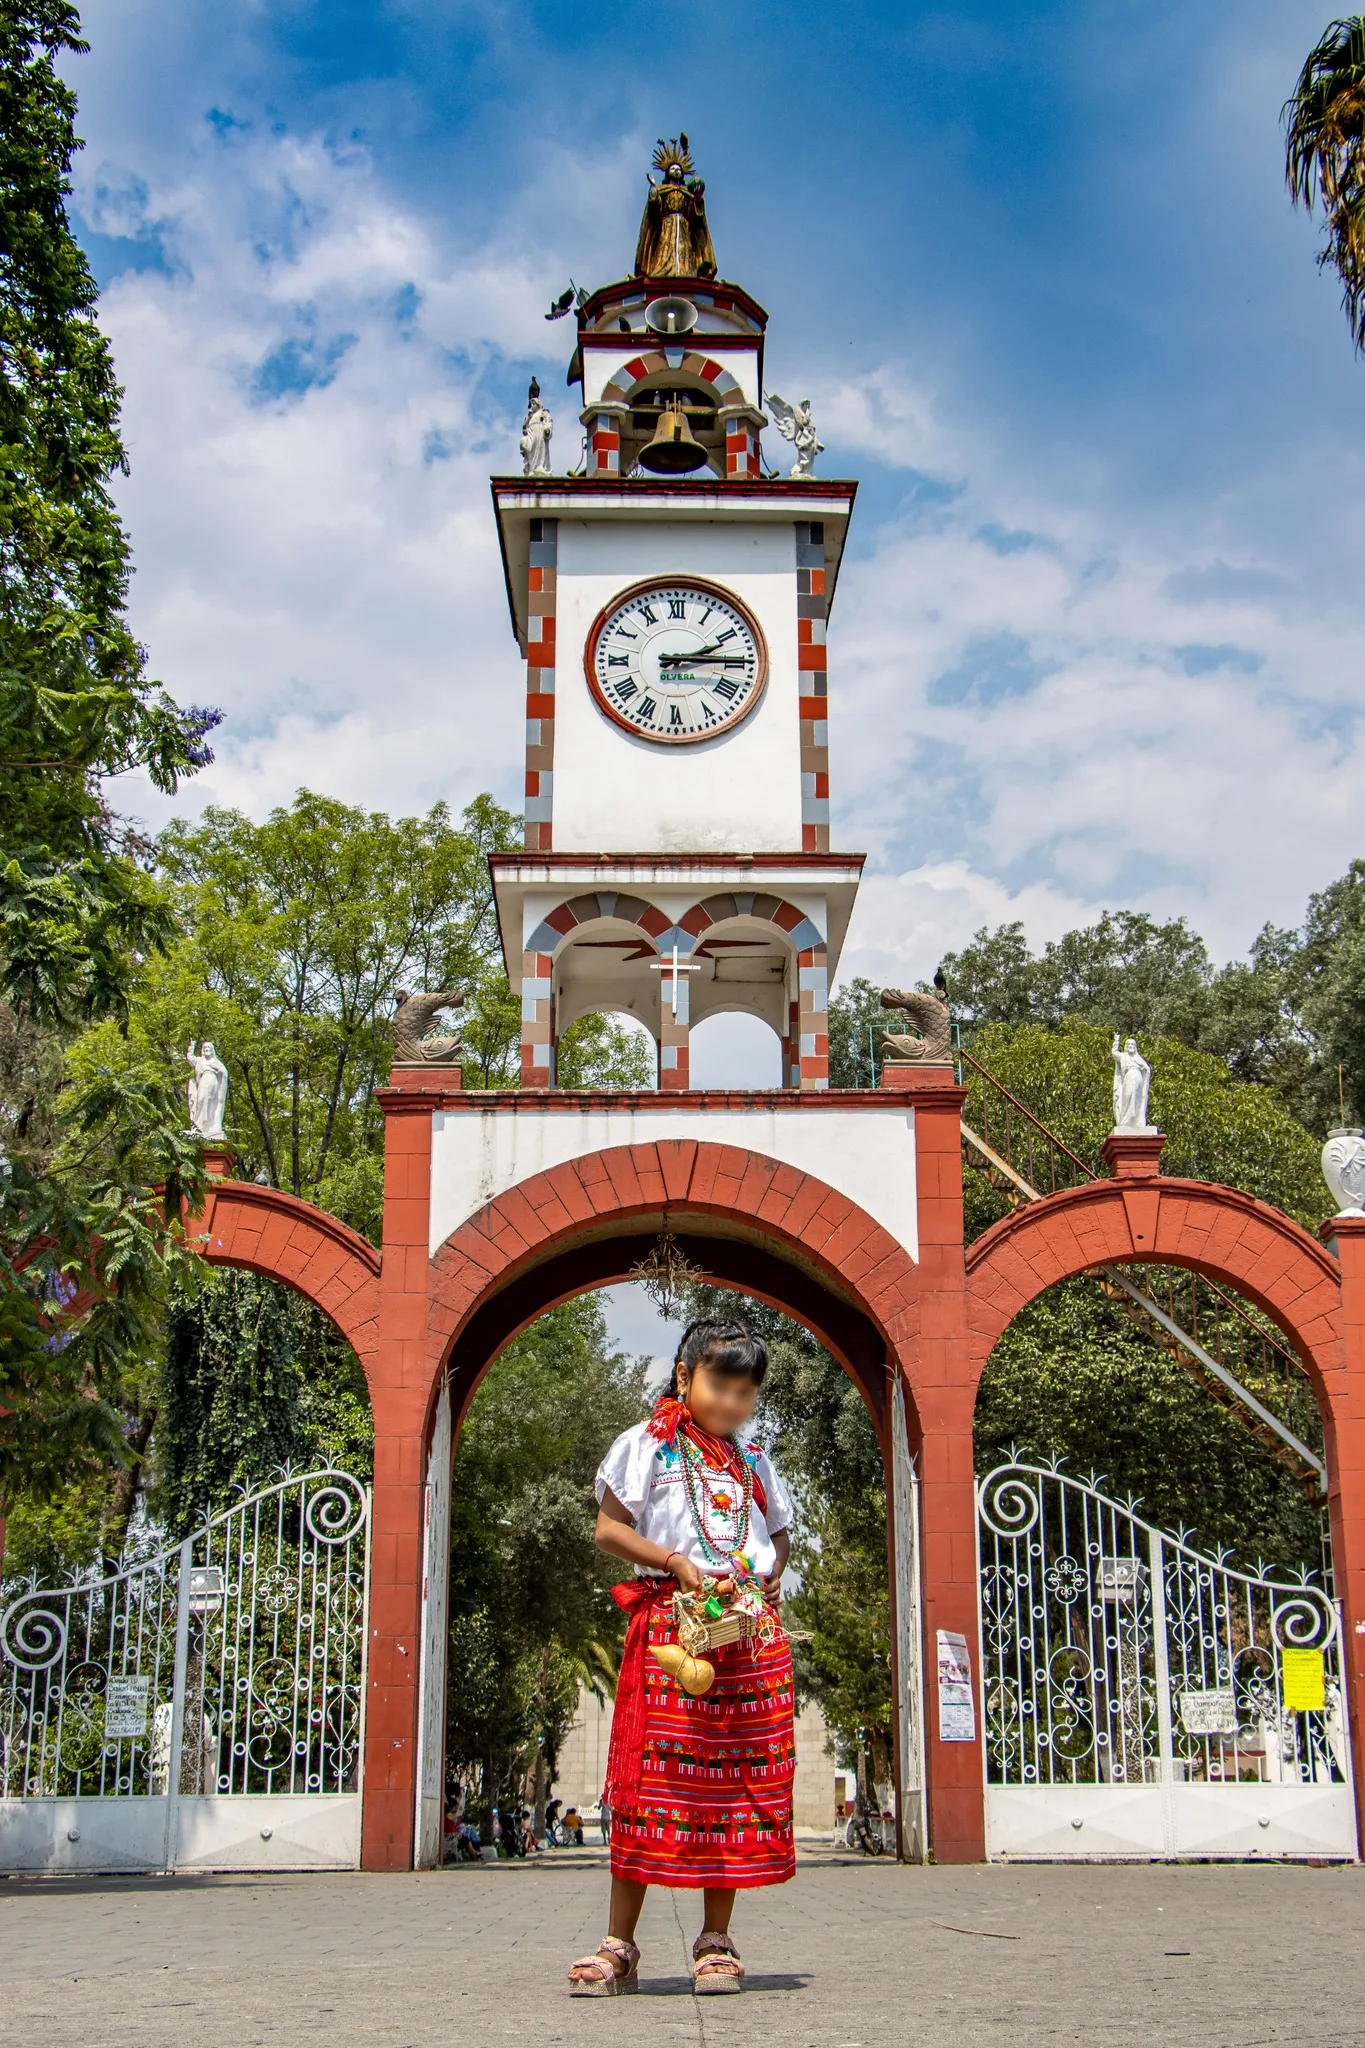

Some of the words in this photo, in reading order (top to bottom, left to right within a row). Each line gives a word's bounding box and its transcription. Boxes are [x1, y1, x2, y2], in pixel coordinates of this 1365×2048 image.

[638, 604, 659, 627] XI
[667, 599, 687, 620] XII
[698, 607, 713, 626] I
[715, 627, 738, 644] II
[660, 673, 696, 681] OLVERA
[669, 704, 684, 725] VI
[700, 701, 716, 720] V
